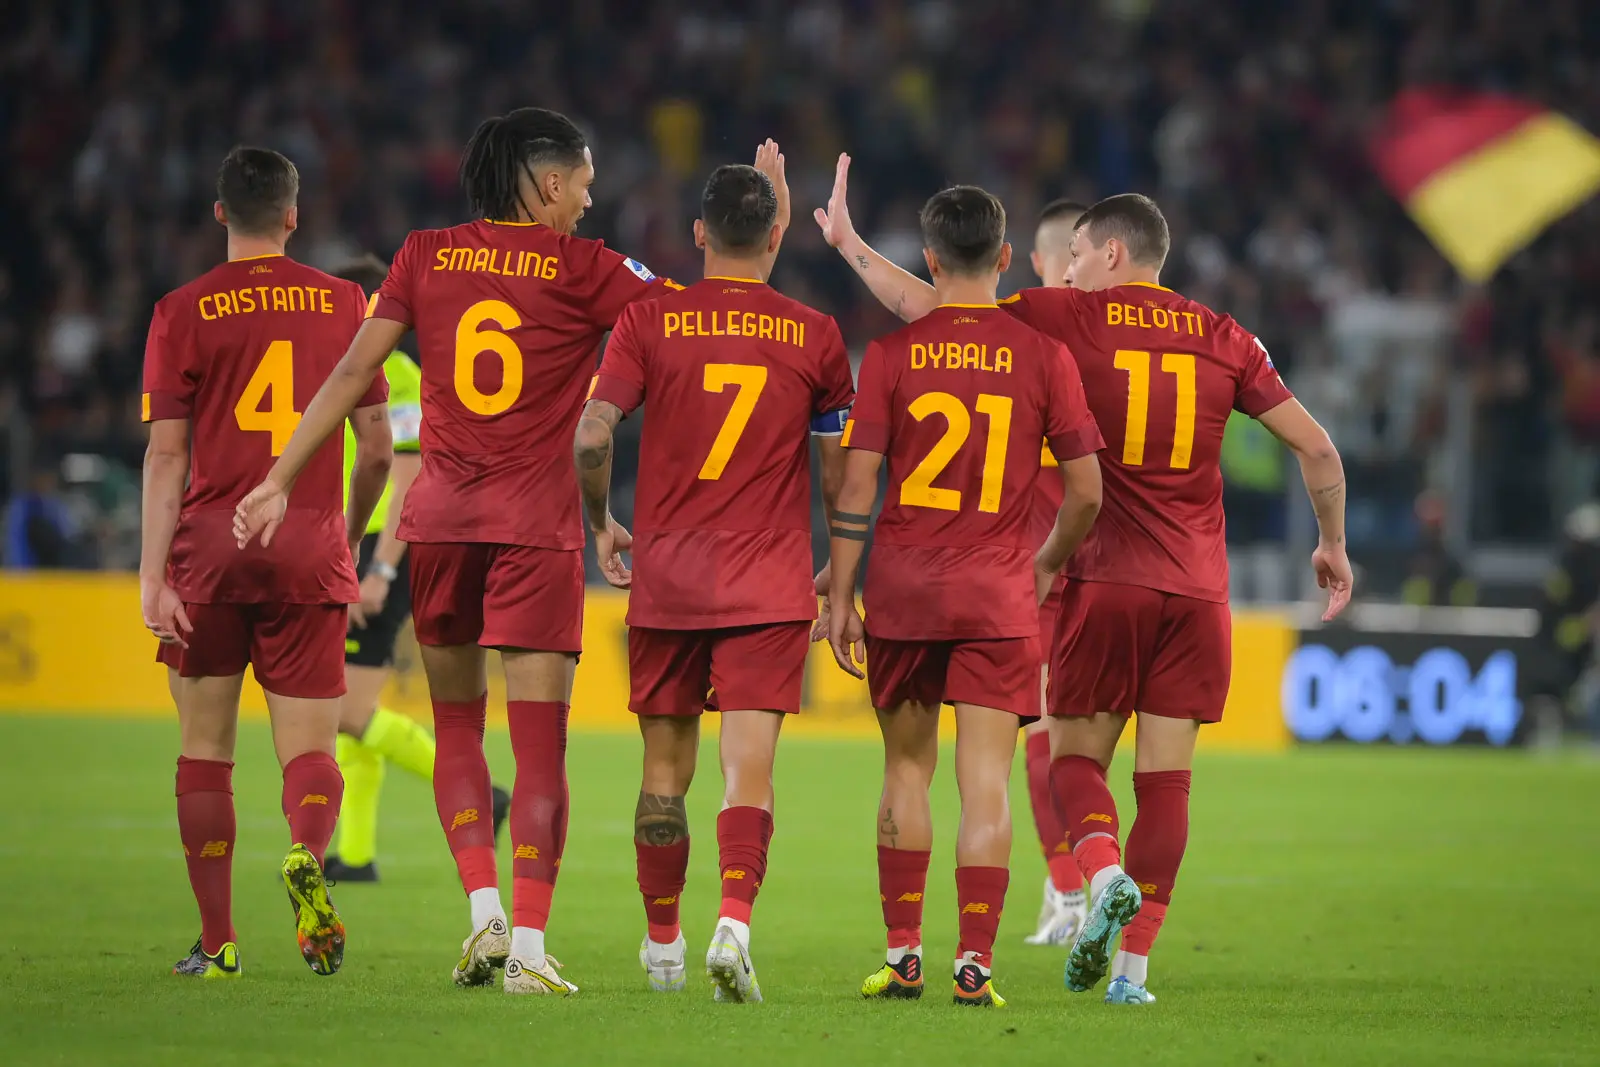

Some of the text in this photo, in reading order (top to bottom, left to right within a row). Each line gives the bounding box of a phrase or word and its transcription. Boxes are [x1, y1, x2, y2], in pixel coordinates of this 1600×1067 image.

[198, 286, 333, 321] CRISTANTE
[433, 247, 559, 280] SMALLING
[454, 300, 523, 416] 6
[664, 310, 805, 348] PELLEGRINI
[911, 343, 1013, 374] DYBALA
[1107, 302, 1204, 337] BELOTTI
[234, 340, 302, 457] 4
[698, 363, 768, 481] 7
[1113, 349, 1196, 469] 11
[900, 391, 1013, 514] 21
[1281, 642, 1523, 746] 06:04
